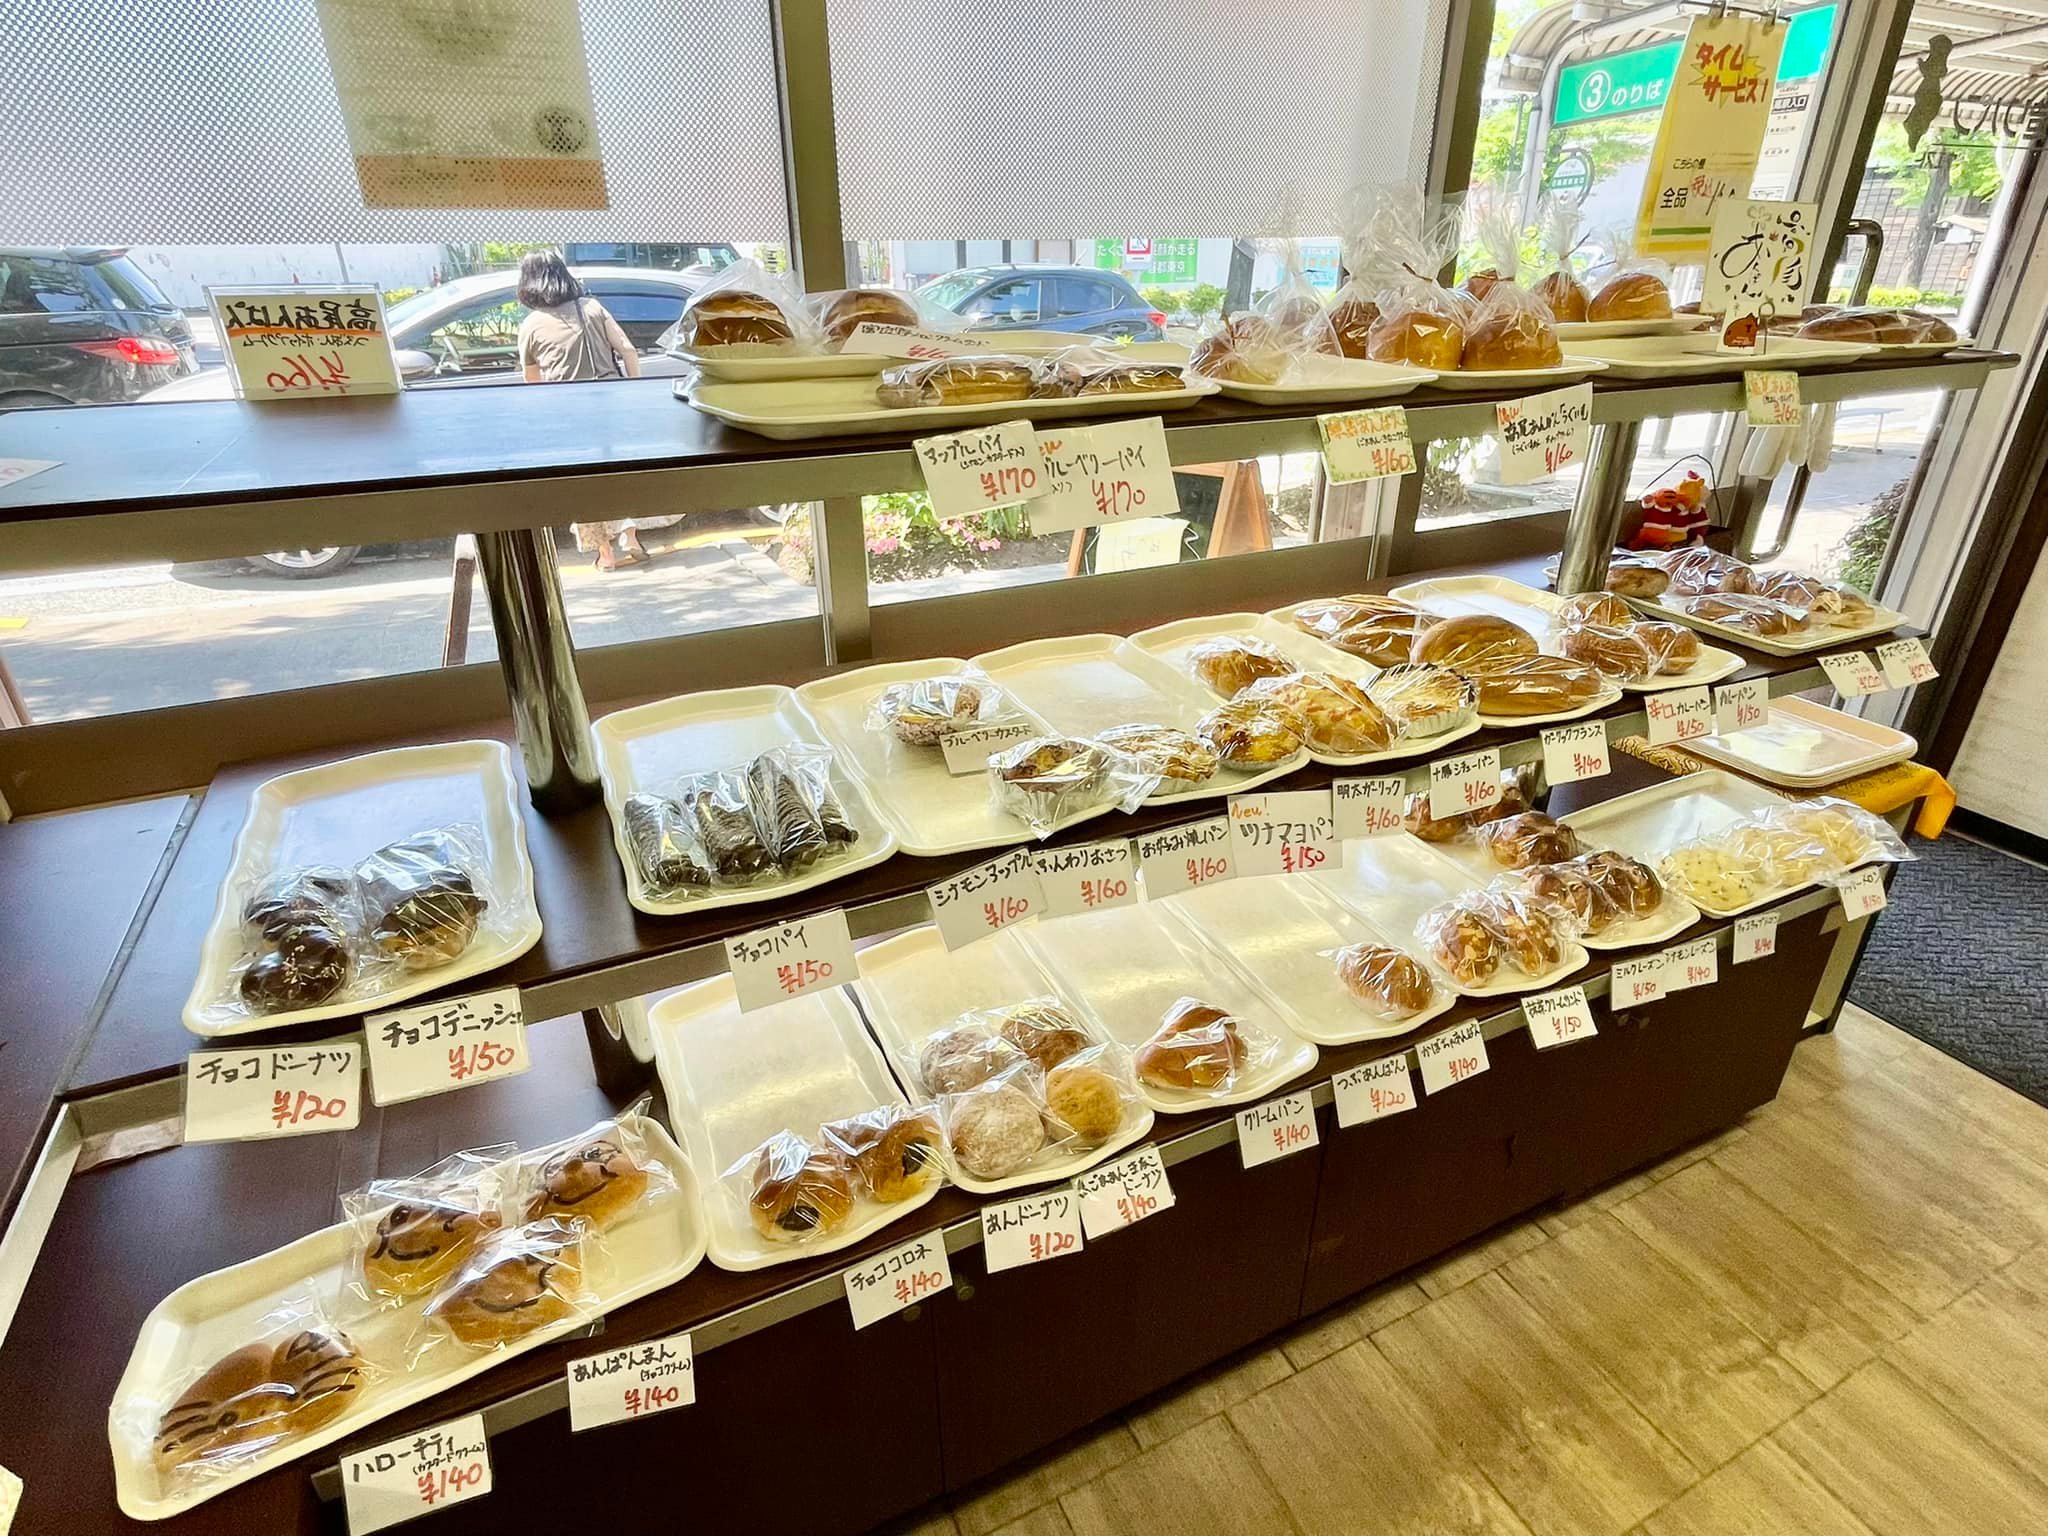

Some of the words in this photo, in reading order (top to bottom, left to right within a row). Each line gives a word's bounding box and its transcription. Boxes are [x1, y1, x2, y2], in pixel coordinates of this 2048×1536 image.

[1696, 42, 1745, 71] タイム
[1660, 187, 1688, 208] 全品
[1371, 448, 1410, 473] ¥160
[1545, 442, 1573, 474] ¥160
[980, 467, 1036, 501] ¥170
[1092, 478, 1146, 516] ¥170
[1719, 686, 1757, 707] カレーパン
[1676, 718, 1705, 738] ¥150
[1736, 706, 1760, 727] ¥150
[1573, 753, 1602, 777] ¥140
[1337, 780, 1401, 800] 明太ガーリック
[1464, 780, 1495, 806] ¥160
[1366, 806, 1400, 834] ¥160
[1187, 858, 1227, 885] ¥160
[1281, 842, 1325, 873] ¥150
[1081, 878, 1128, 907] ¥160
[984, 897, 1029, 928] ¥160
[733, 926, 809, 963] チョコパイ
[777, 960, 833, 995] ¥150
[1615, 959, 1665, 979] ミルクレーズン
[1633, 983, 1657, 1000] ¥150
[382, 1003, 522, 1048] チョコデニッシュ
[1552, 1015, 1581, 1038] ¥150
[197, 1052, 351, 1085] チョコドーナツ
[448, 1042, 516, 1080] ¥150
[1448, 1057, 1478, 1081] ¥140
[271, 1089, 347, 1129] ¥120
[1370, 1087, 1406, 1112] ¥120
[1244, 1099, 1305, 1131] クリームパン
[1273, 1124, 1310, 1151] ¥140
[986, 1196, 1069, 1235] あんドーナツ
[1117, 1194, 1157, 1224] ¥140
[1030, 1232, 1075, 1261] ¥120
[850, 1244, 933, 1291] チョココロネ
[894, 1270, 943, 1304] ¥140
[572, 1343, 677, 1383] あんぱんまん
[624, 1386, 679, 1415] ¥140
[352, 1432, 454, 1483] ハローキティ
[417, 1462, 484, 1504] ¥140
